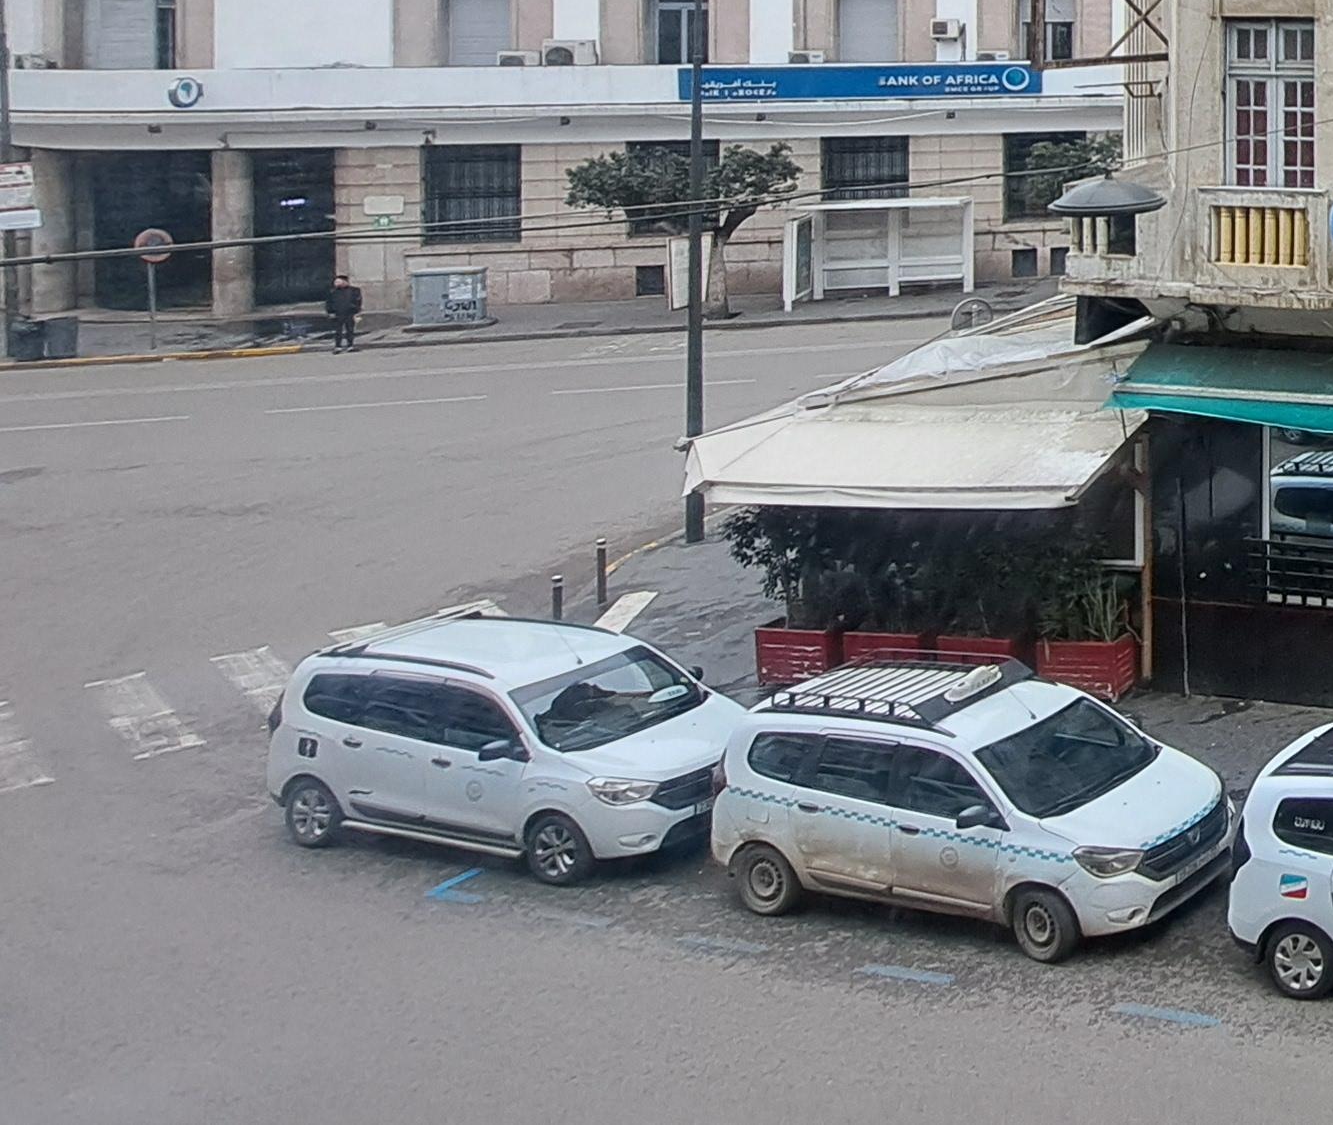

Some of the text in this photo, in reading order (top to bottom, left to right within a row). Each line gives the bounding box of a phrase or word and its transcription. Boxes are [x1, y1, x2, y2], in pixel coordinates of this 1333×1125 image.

[878, 74, 999, 86] BANK OF AFRICA
